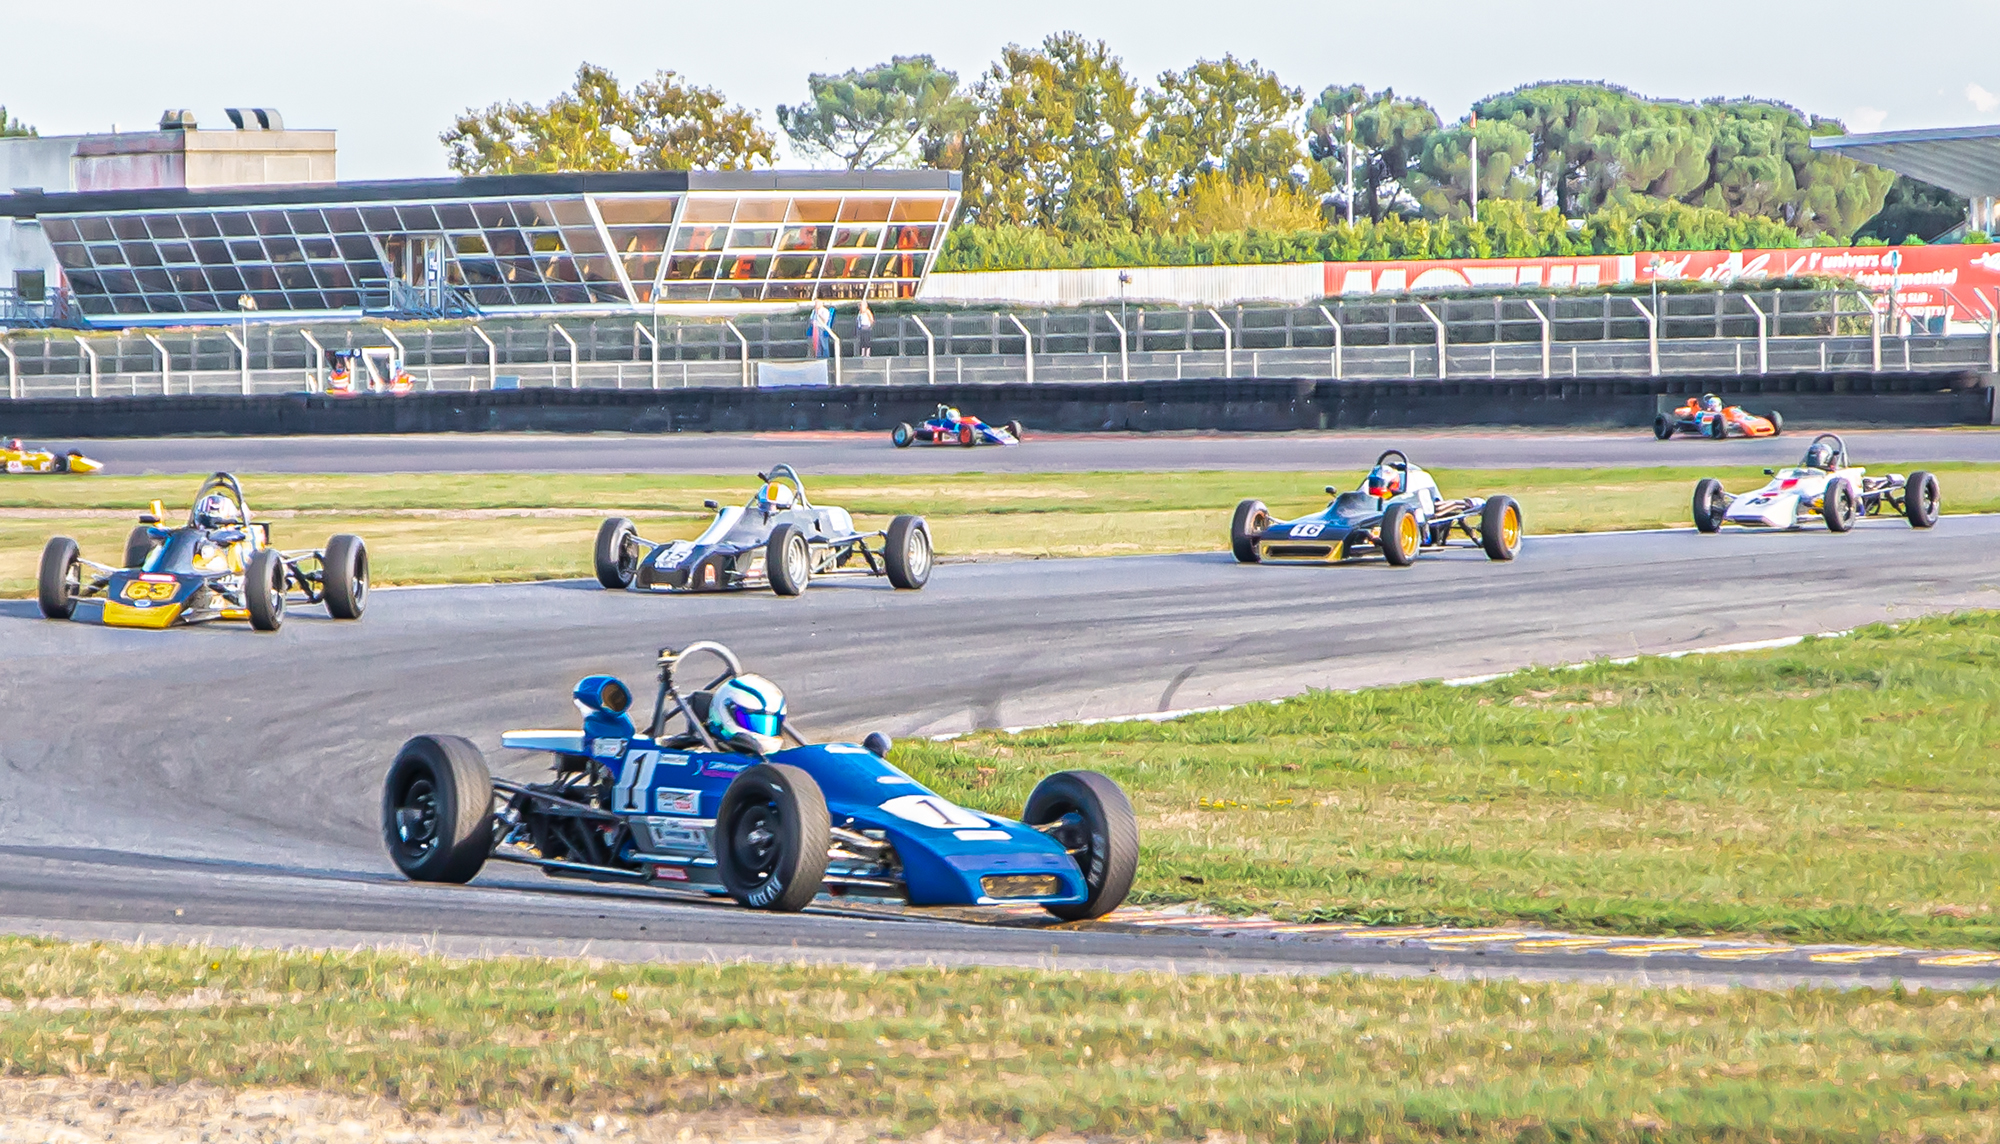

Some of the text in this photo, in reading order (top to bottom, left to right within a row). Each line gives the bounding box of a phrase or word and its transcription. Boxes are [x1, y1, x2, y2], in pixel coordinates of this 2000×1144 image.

[1296, 524, 1321, 536] 16
[126, 580, 174, 600] 63
[623, 752, 649, 810] 1
[915, 799, 962, 825] 1
